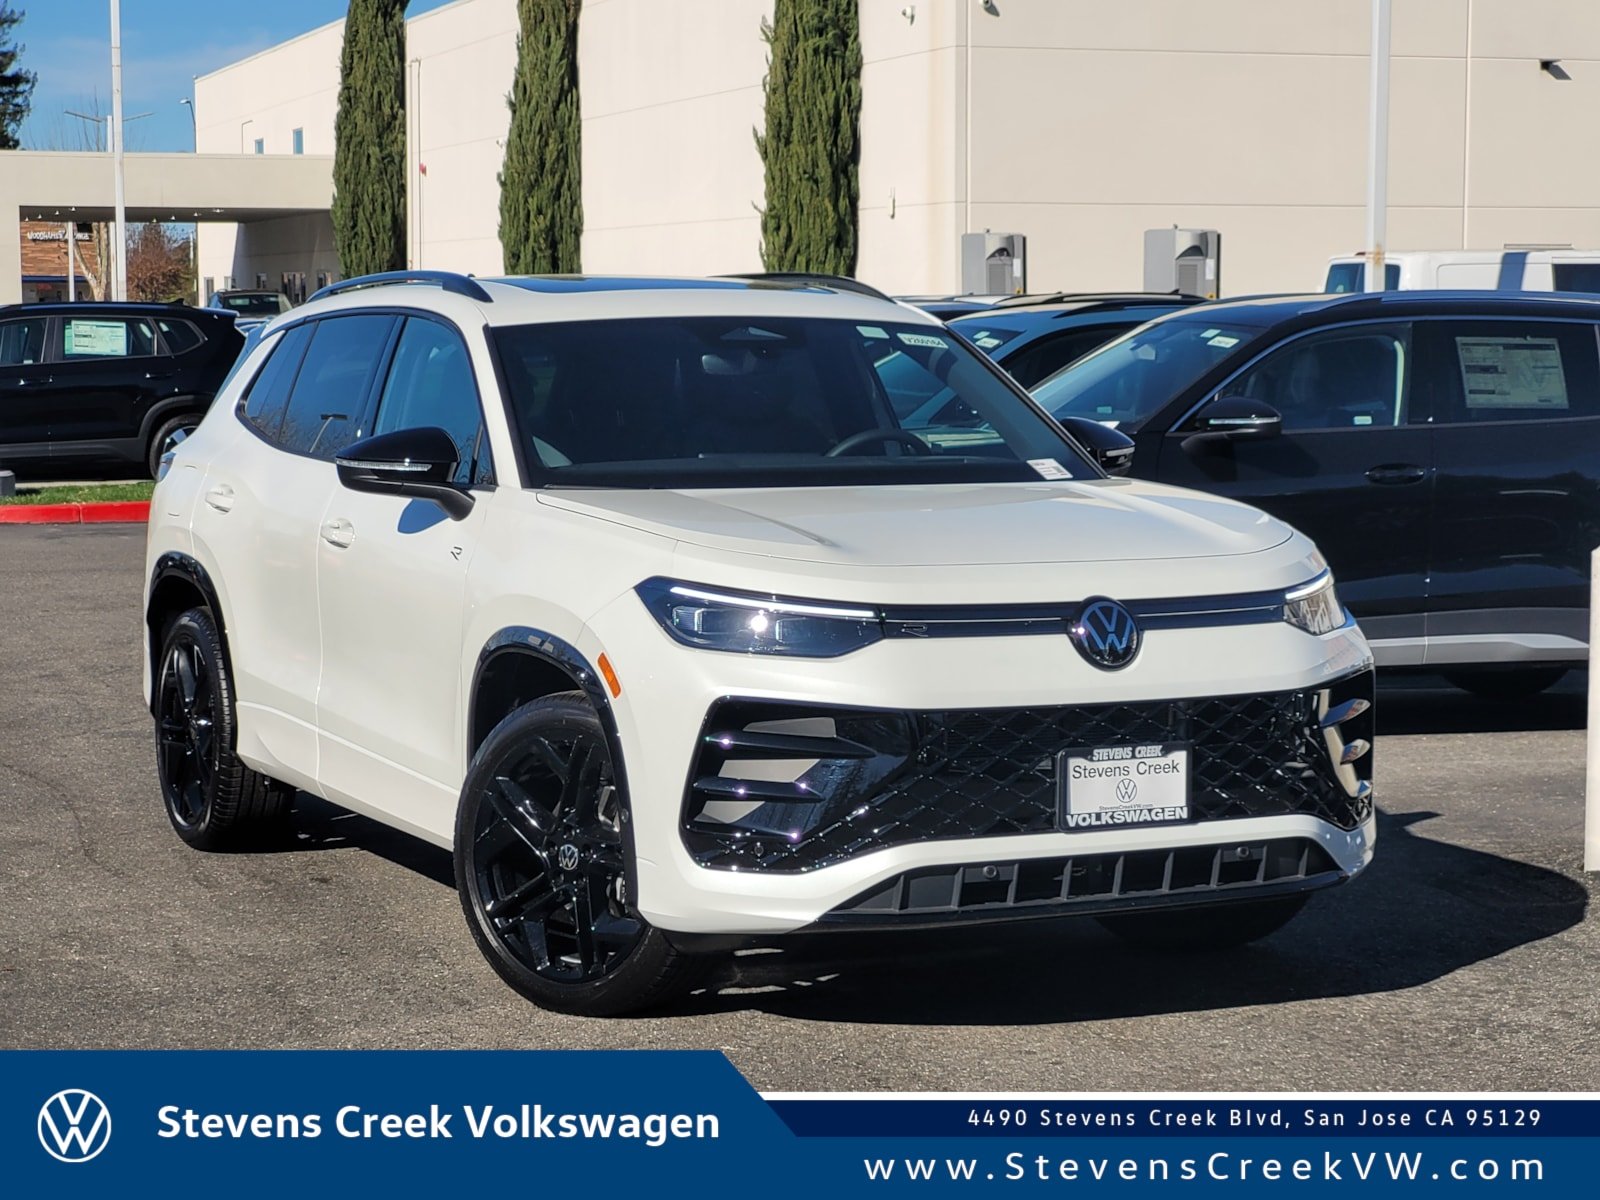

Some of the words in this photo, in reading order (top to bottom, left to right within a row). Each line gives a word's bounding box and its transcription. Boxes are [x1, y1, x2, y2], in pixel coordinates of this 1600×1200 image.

[1092, 747, 1133, 761] STEVENS
[1135, 745, 1163, 758] CREEK
[1072, 765, 1131, 779] Stevens
[1136, 760, 1180, 776] Creek
[1066, 807, 1188, 827] VOLKSWAGEN
